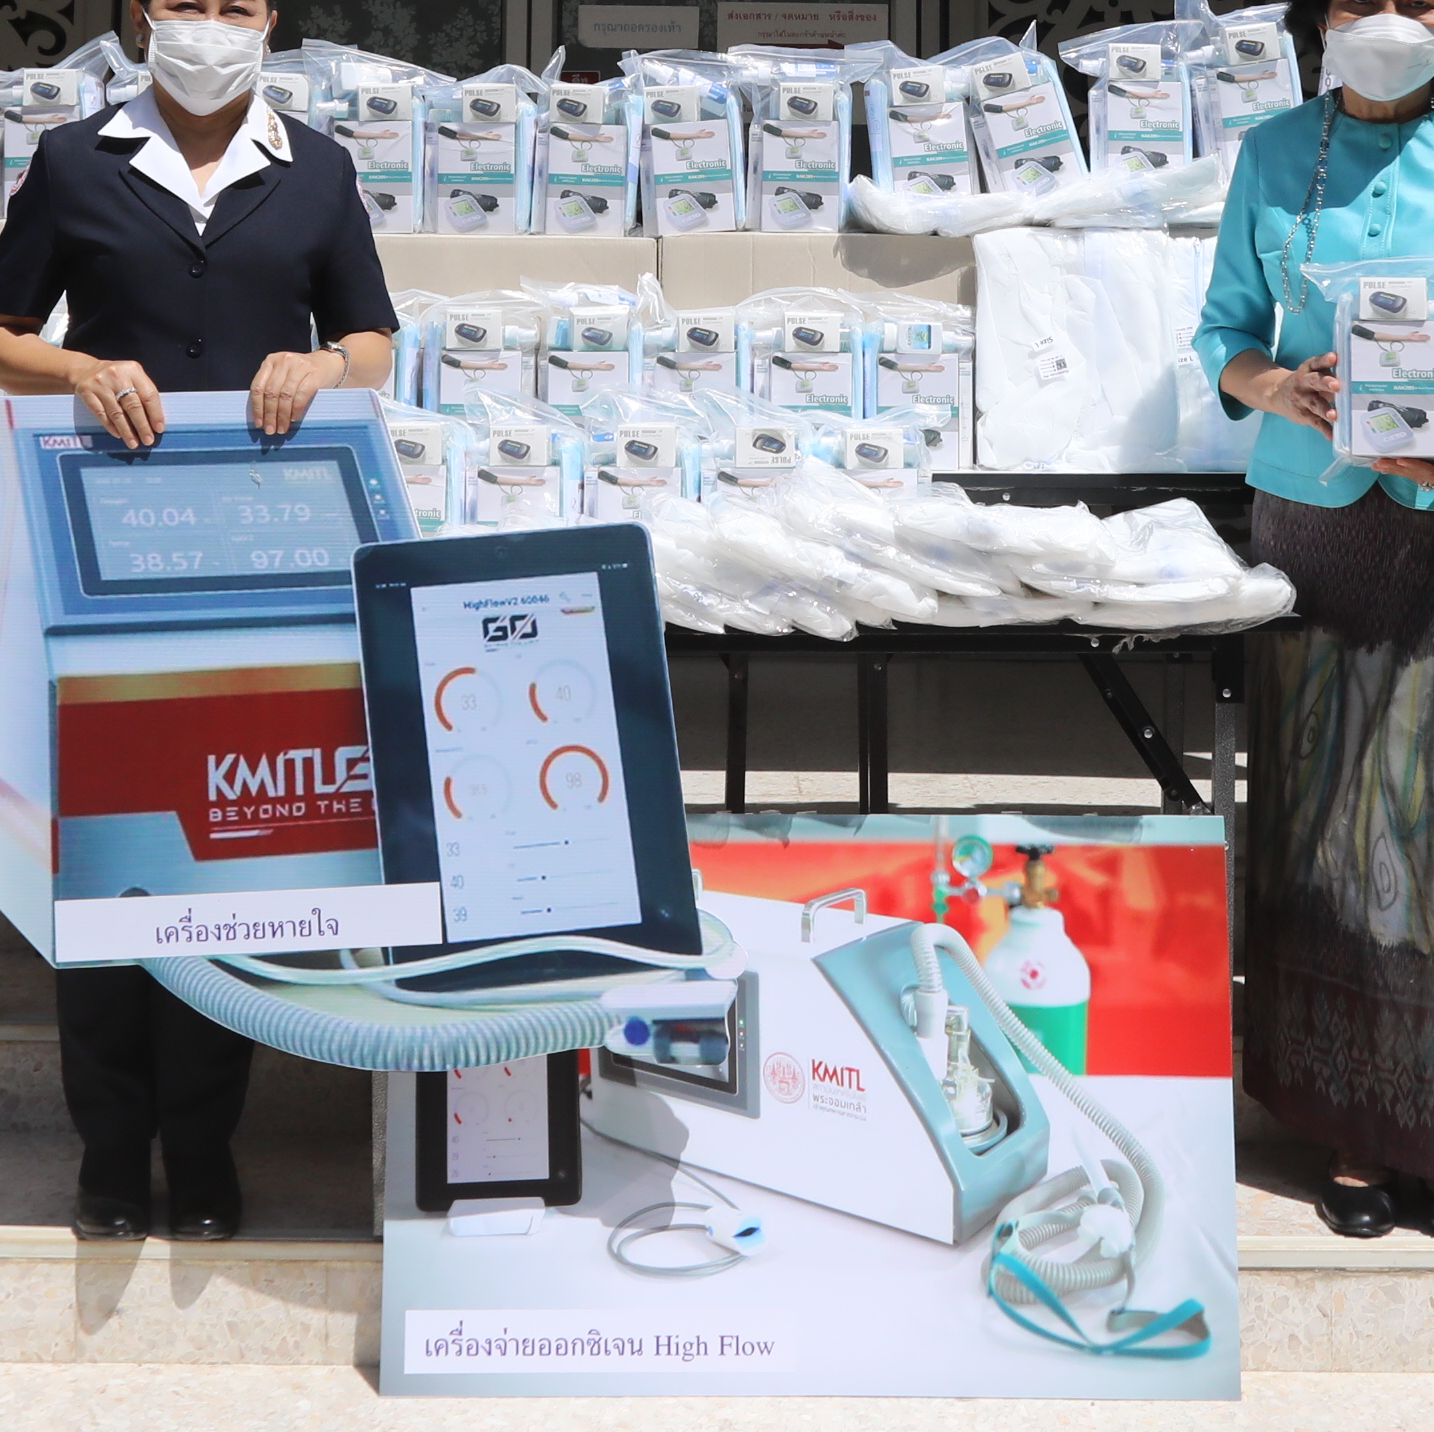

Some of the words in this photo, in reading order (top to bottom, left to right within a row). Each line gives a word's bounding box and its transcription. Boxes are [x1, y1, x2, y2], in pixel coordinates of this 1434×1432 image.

[1228, 31, 1247, 39] PULSE
[974, 64, 993, 75] PULSE
[26, 72, 45, 80] PULSE
[893, 71, 911, 80] PULSE
[361, 87, 380, 95] PULSE
[465, 88, 483, 96] PULSE
[552, 88, 571, 97] PULSE
[782, 86, 801, 94] PULSE
[1252, 98, 1291, 111] Electronic
[1024, 120, 1064, 138] Electronic
[1140, 120, 1179, 129] Electronic
[924, 142, 964, 152] Electronic
[367, 161, 409, 170] Electronic
[470, 162, 512, 172] Electronic
[581, 164, 622, 173] Electronic
[686, 159, 727, 169] Electronic
[795, 160, 836, 169] Electronic
[1364, 281, 1387, 289] PULSE
[450, 313, 469, 321] PULSE
[577, 317, 596, 325] PULSE
[682, 317, 701, 325] PULSE
[806, 394, 848, 404] Electronic
[912, 395, 954, 405] Electronic
[493, 429, 513, 438] PULSE
[620, 430, 640, 438] PULSE
[850, 433, 870, 441] PULSE
[122, 508, 196, 527] 40.04
[238, 504, 311, 524] 33.79
[129, 552, 204, 572] 38.57
[251, 548, 329, 568] 97.00
[208, 802, 306, 823] BEYOND
[317, 797, 362, 814] THE
[155, 907, 339, 945] เครื่องช่วยหายใจ
[811, 1058, 865, 1092] KMITL
[425, 1321, 643, 1357] เครื่องจ่ายออกซิเจน
[654, 1334, 709, 1362] High
[718, 1335, 775, 1356] Flow
